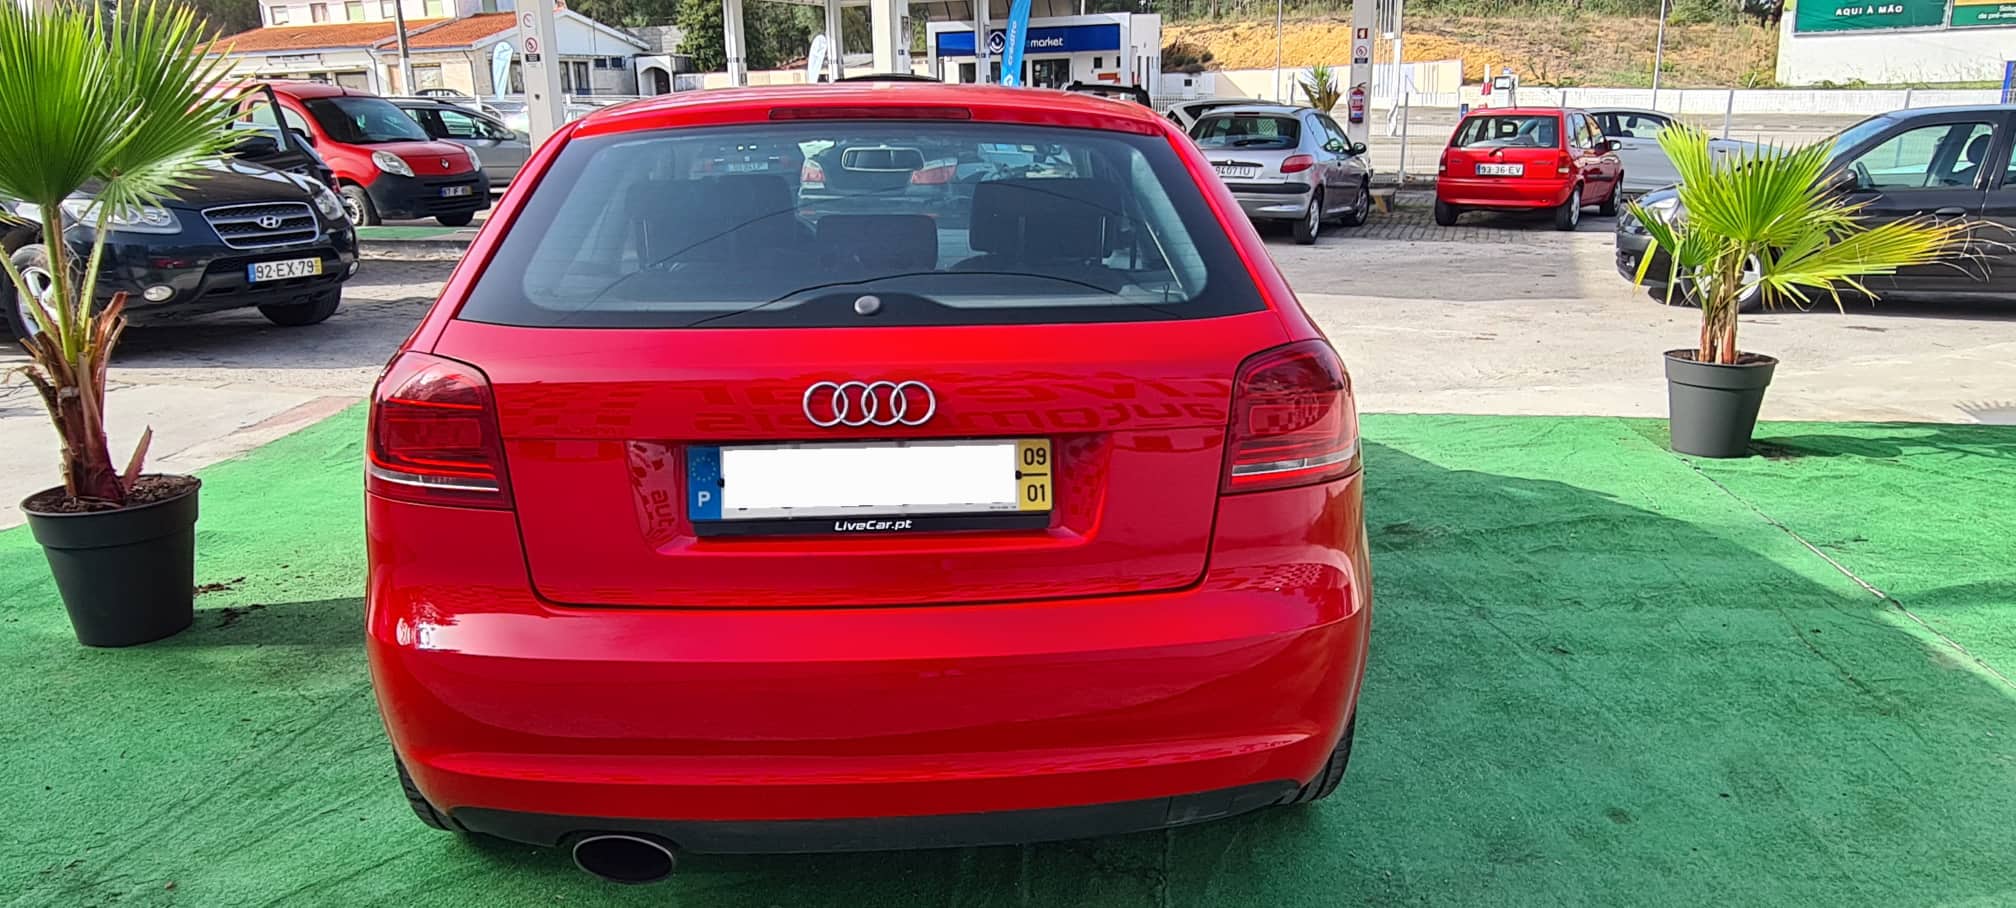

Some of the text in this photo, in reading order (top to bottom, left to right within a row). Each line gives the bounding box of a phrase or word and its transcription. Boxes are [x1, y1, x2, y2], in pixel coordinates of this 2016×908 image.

[1835, 7, 1863, 16] AQUI
[1878, 4, 1903, 14] MÃO
[1030, 36, 1064, 48] market
[1023, 447, 1047, 465] 09
[697, 491, 711, 507] P
[1026, 484, 1046, 502] 01
[834, 519, 913, 531] LiveCar.pt
